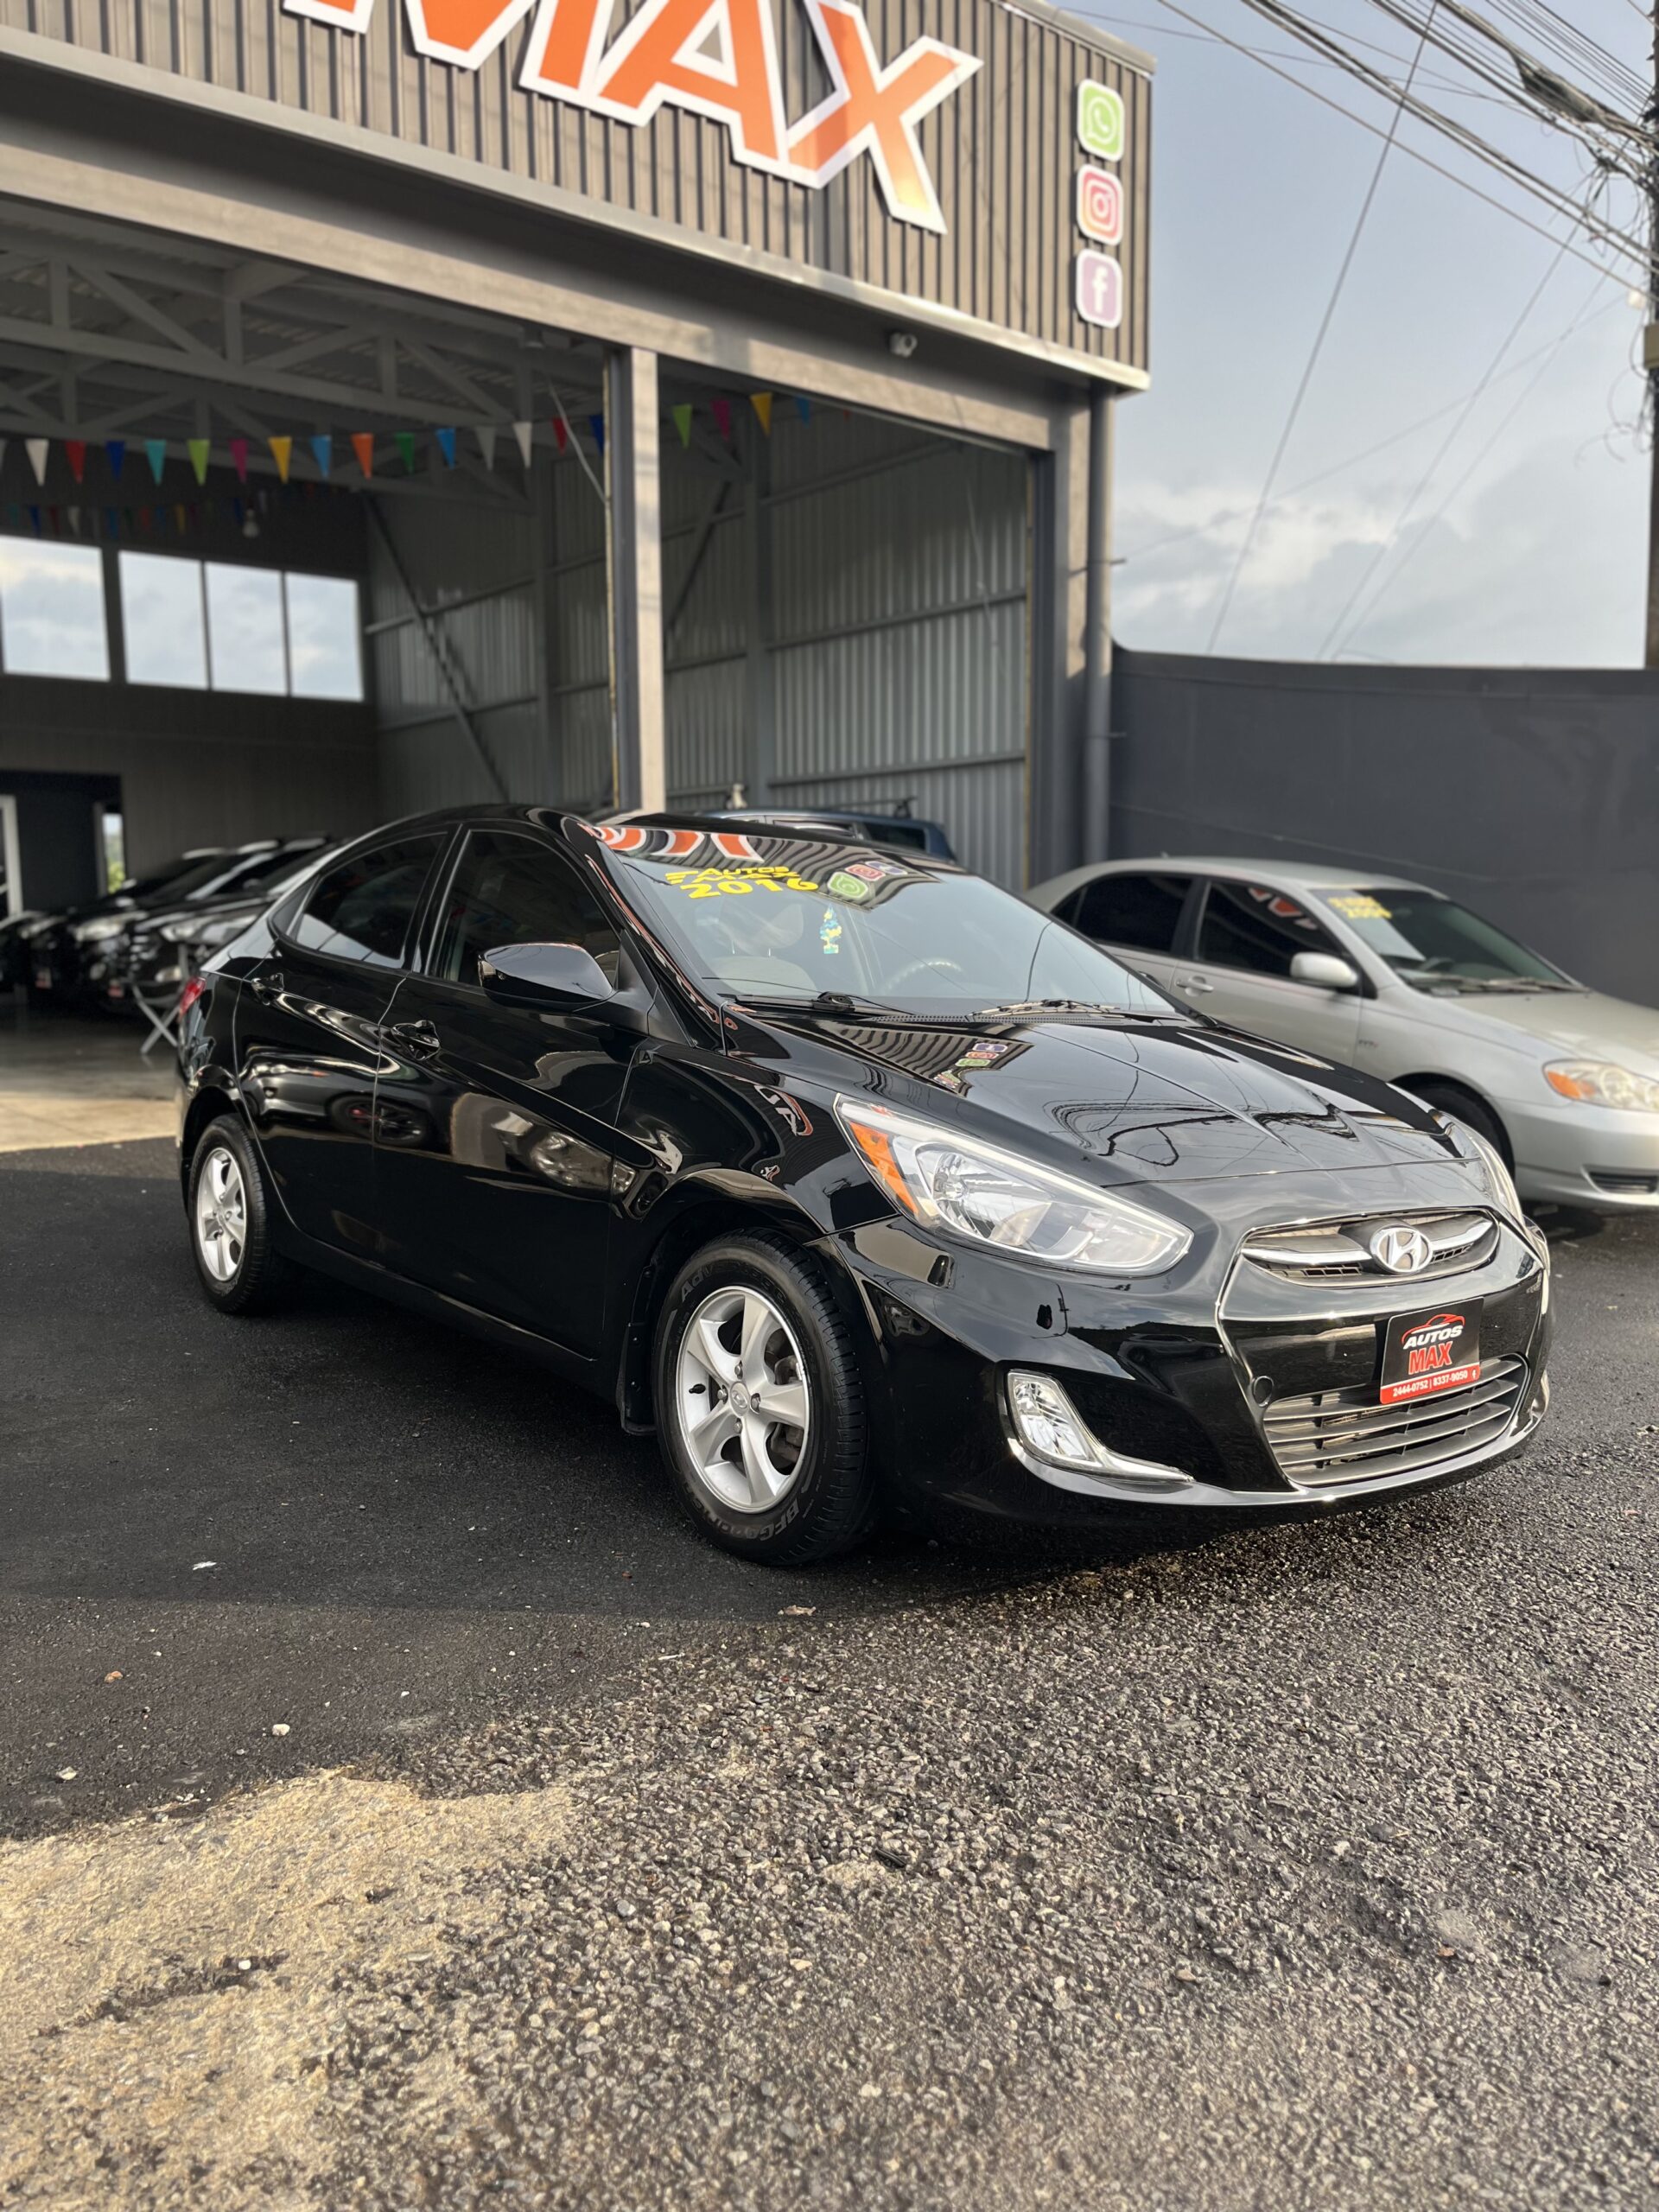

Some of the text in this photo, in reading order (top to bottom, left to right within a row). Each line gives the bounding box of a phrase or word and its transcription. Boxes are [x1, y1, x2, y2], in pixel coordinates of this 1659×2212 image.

[680, 878, 818, 899] 2016
[1403, 1325, 1463, 1350] AUTOS
[1408, 1341, 1453, 1375] MAX
[1393, 1380, 1428, 1397] 2444-0752
